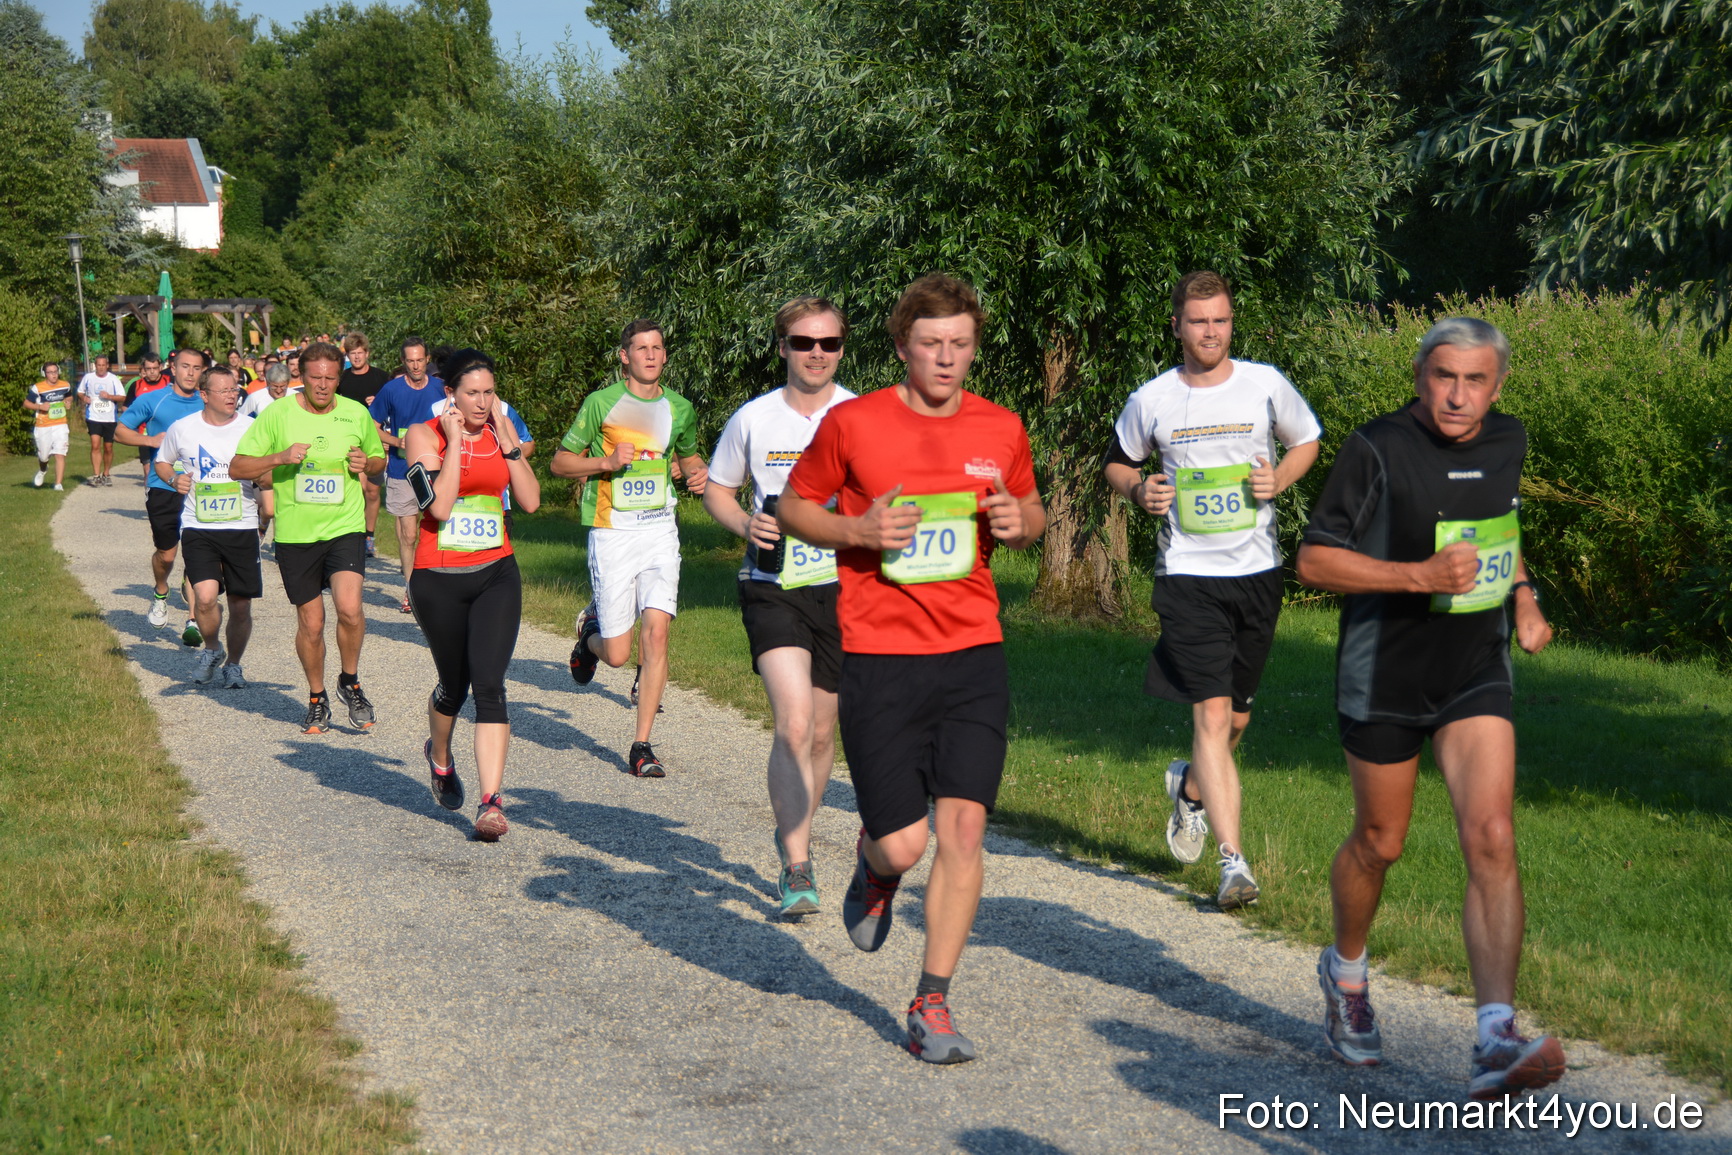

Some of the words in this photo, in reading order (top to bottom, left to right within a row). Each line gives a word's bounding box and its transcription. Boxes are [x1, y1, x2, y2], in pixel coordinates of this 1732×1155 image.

[304, 478, 336, 494] 260
[622, 480, 656, 496] 999
[201, 497, 237, 511] 1477
[1194, 492, 1241, 516] 536
[446, 516, 498, 538] 1383
